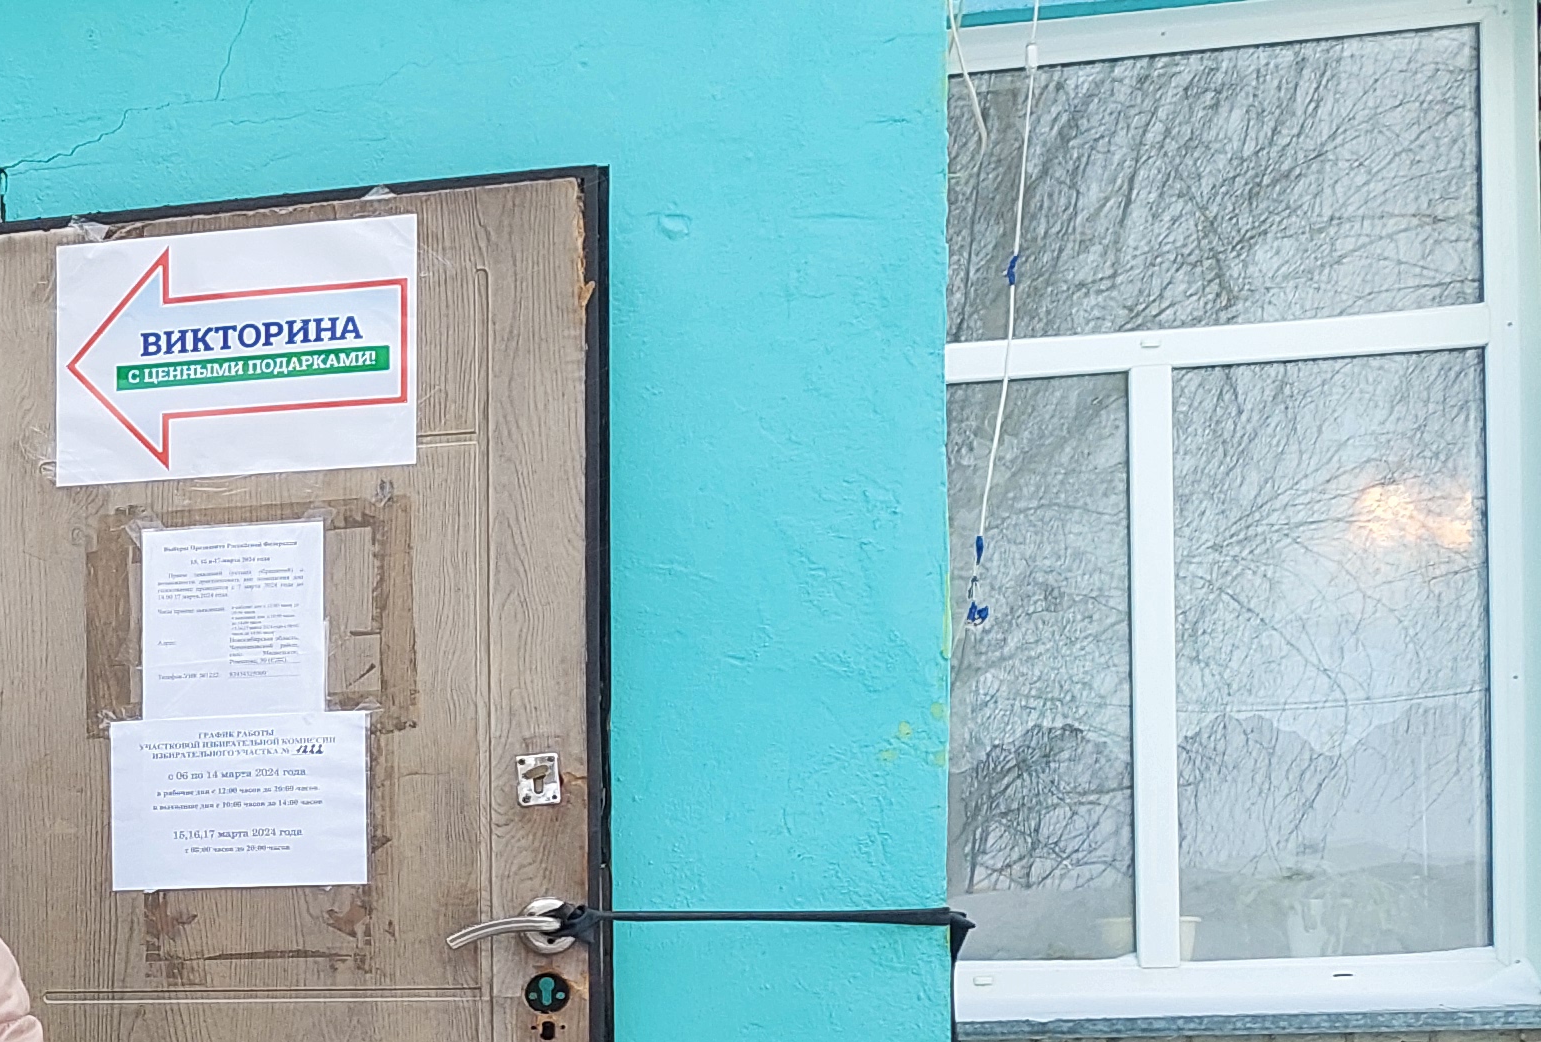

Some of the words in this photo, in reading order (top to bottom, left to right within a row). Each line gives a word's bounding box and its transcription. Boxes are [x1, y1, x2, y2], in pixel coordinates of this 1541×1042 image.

[140, 315, 363, 357] ВИКТОРИНА
[128, 370, 141, 384] С
[143, 362, 245, 385] ЦЕННЫМИ
[247, 351, 377, 375] ПОДАРКАМИ!
[255, 768, 280, 777] 2024
[252, 828, 277, 837] 2024
